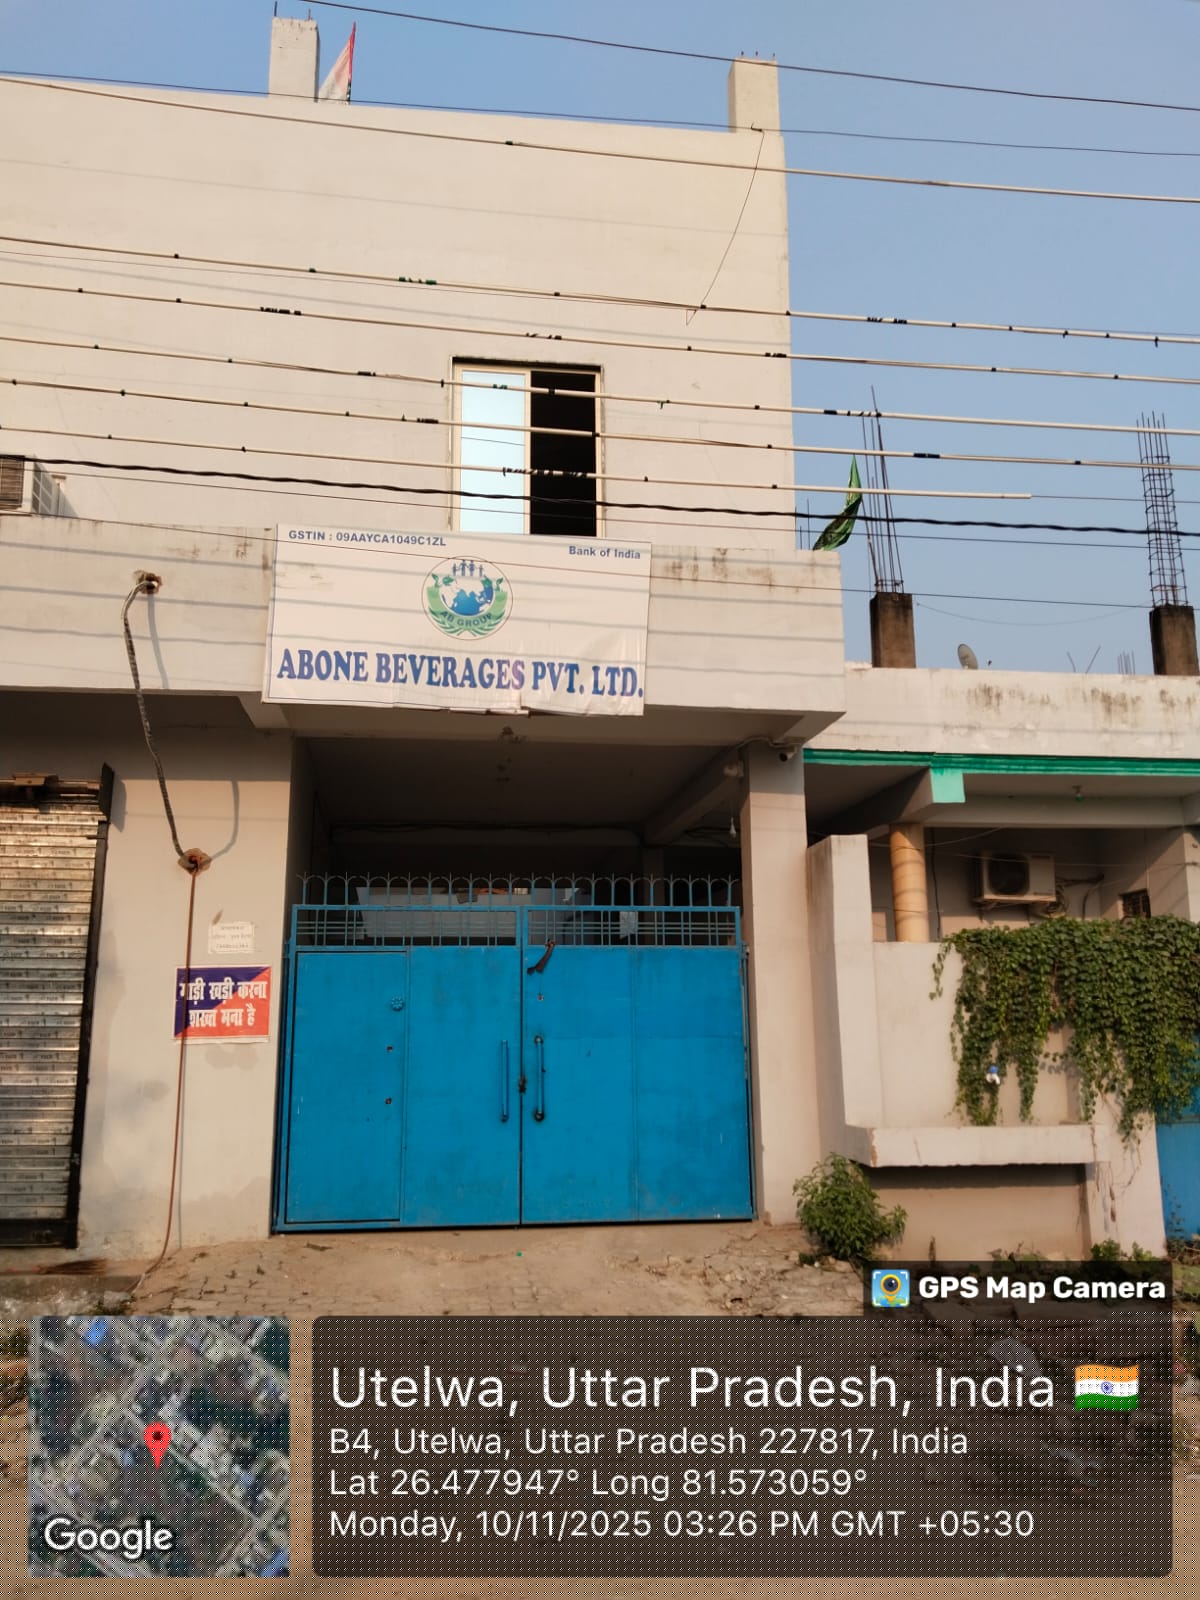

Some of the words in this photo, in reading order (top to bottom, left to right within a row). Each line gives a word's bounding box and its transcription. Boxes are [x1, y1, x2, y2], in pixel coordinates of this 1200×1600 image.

[289, 530, 325, 540] GSTIN
[336, 532, 446, 546] 09AAYCA1049C1ZL
[569, 546, 596, 557] Bank
[600, 548, 610, 558] of
[614, 549, 641, 559] India
[457, 613, 492, 627] GROUP
[277, 648, 369, 682] ABONE
[376, 653, 525, 690] BEVERAGES
[532, 661, 585, 695] PVT.
[592, 665, 643, 699] LTD.
[237, 981, 268, 999] करना
[220, 1008, 244, 1027] मना
[246, 1002, 256, 1027] है
